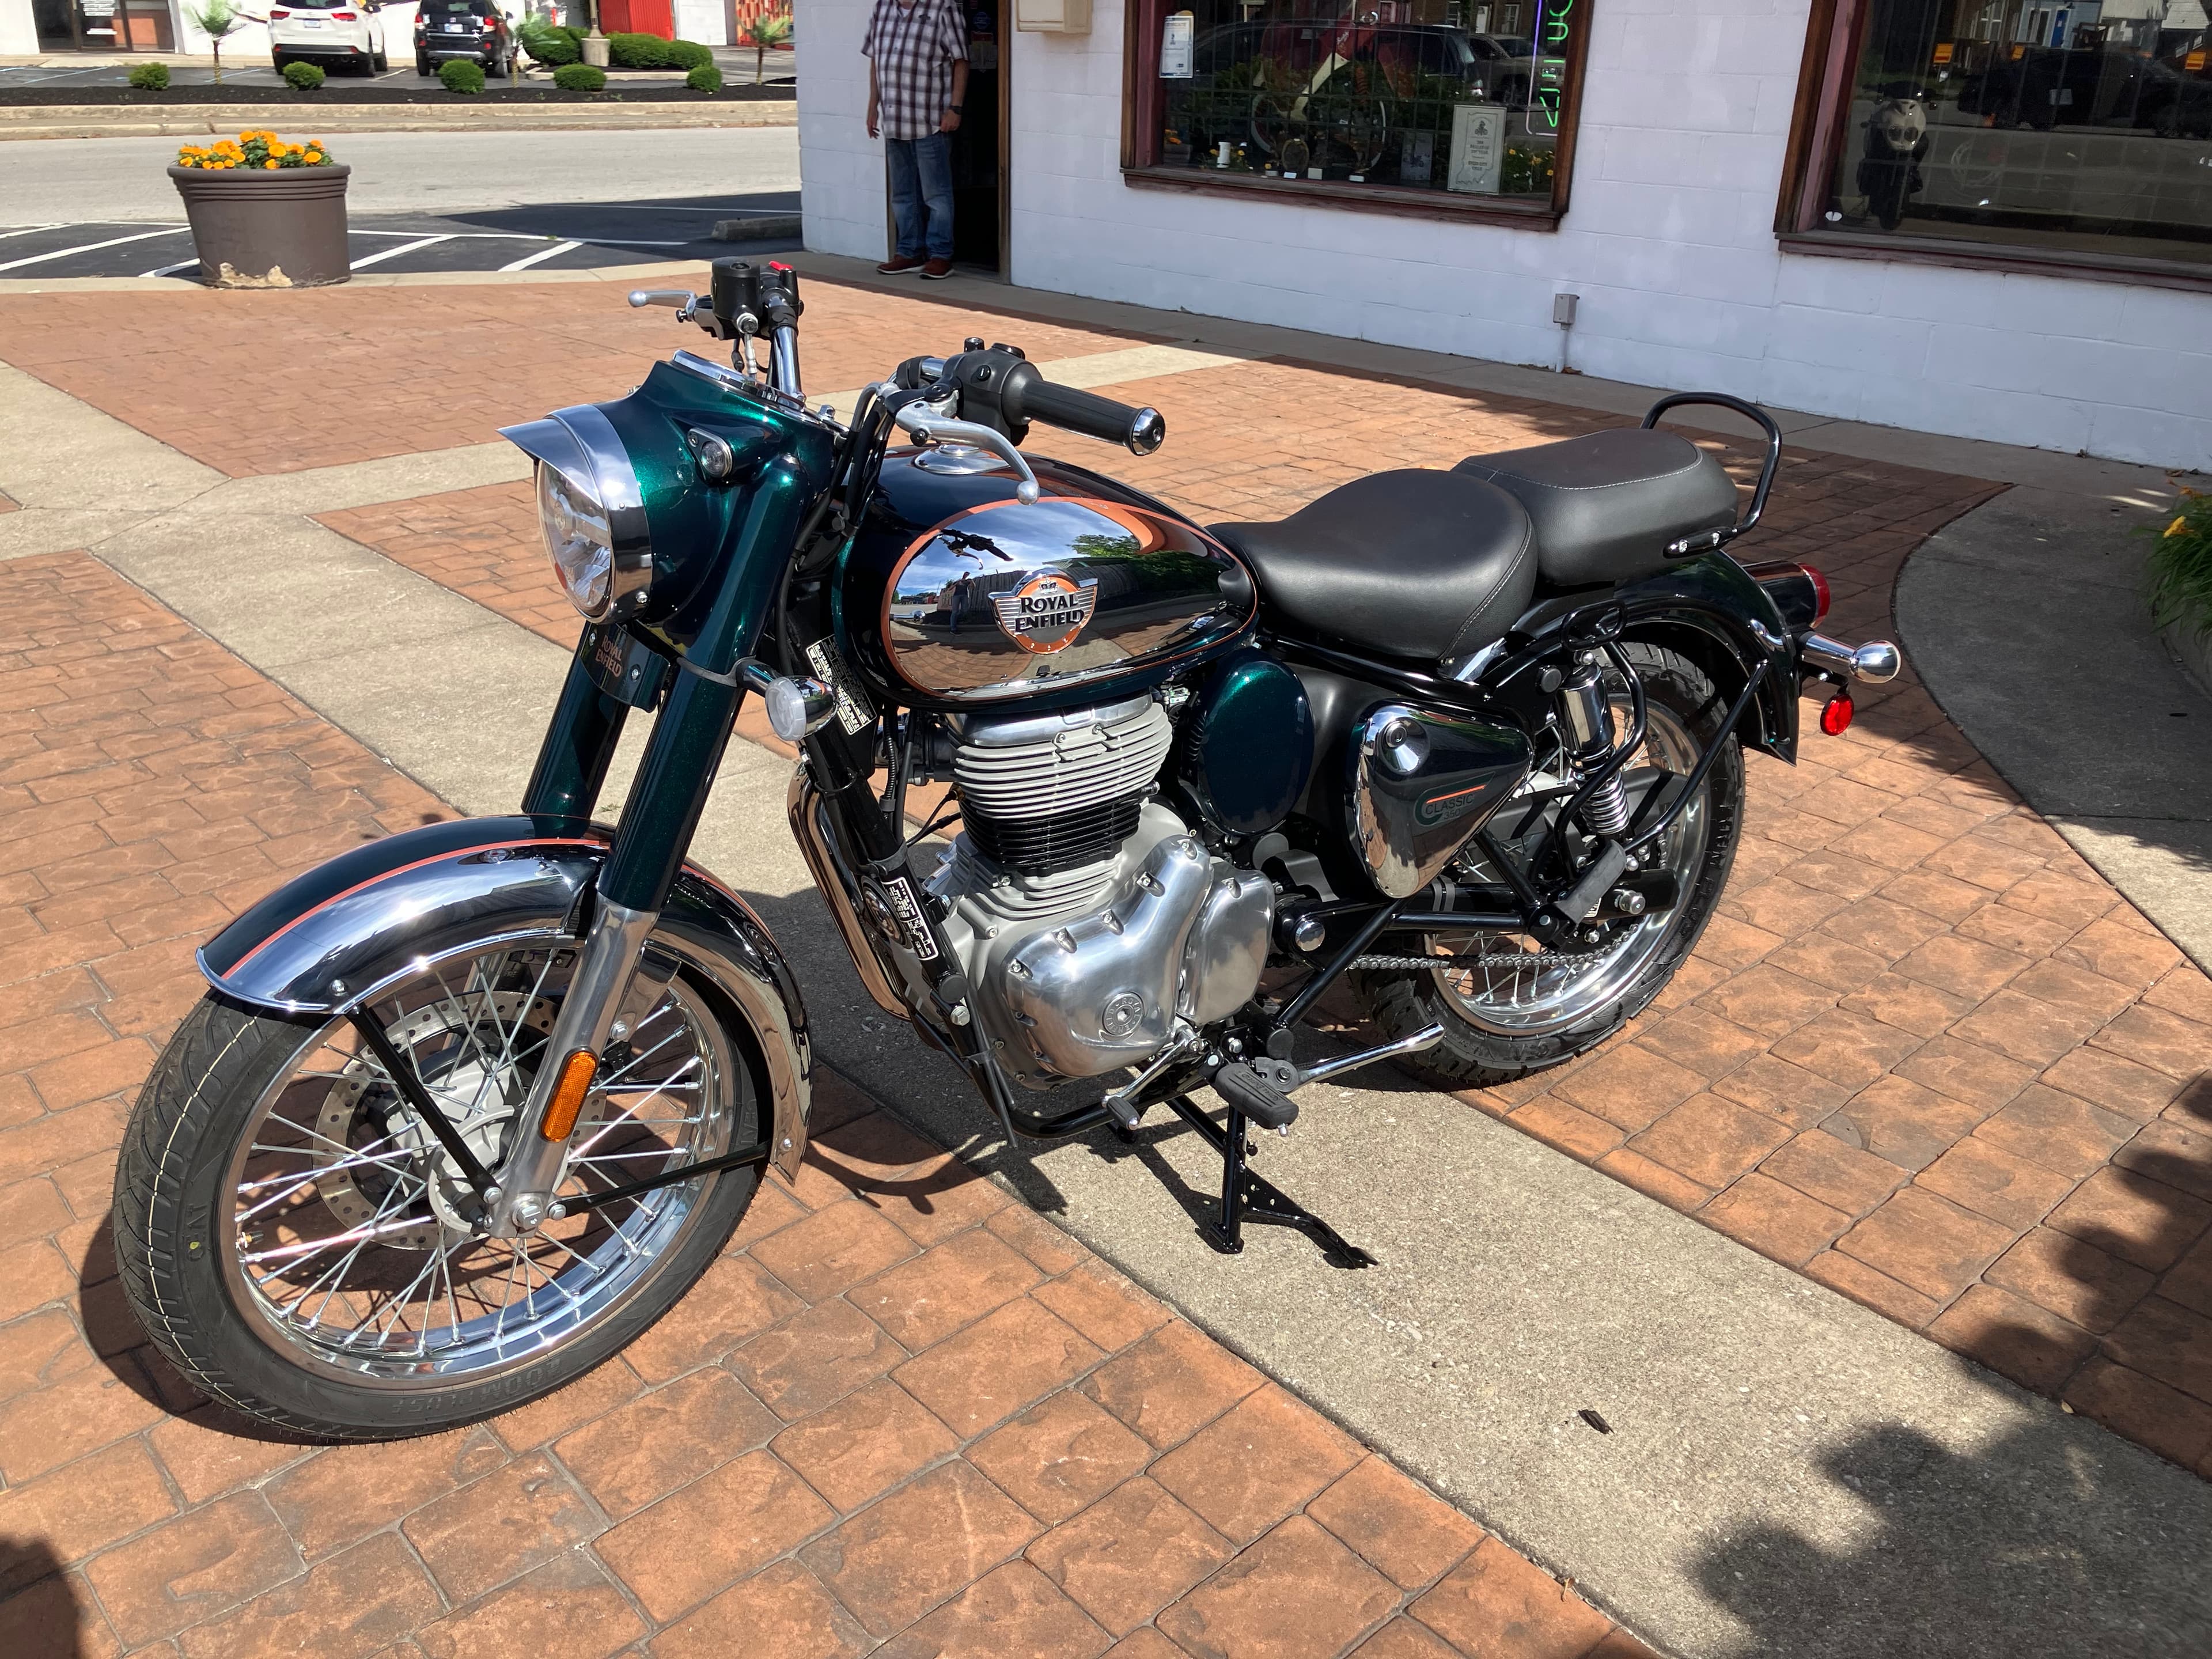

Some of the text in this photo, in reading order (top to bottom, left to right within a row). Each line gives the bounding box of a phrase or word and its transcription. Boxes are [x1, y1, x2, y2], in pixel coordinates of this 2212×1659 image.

[1020, 593, 1079, 614] ROYAL
[1014, 609, 1085, 634] ENFIELD
[601, 635, 623, 661] ROYAL
[595, 649, 622, 677] ENFIELD
[1426, 794, 1474, 815] CLASSIC
[1442, 808, 1461, 820] 350
[1106, 997, 1141, 1032] ROYAL ENFIELD
